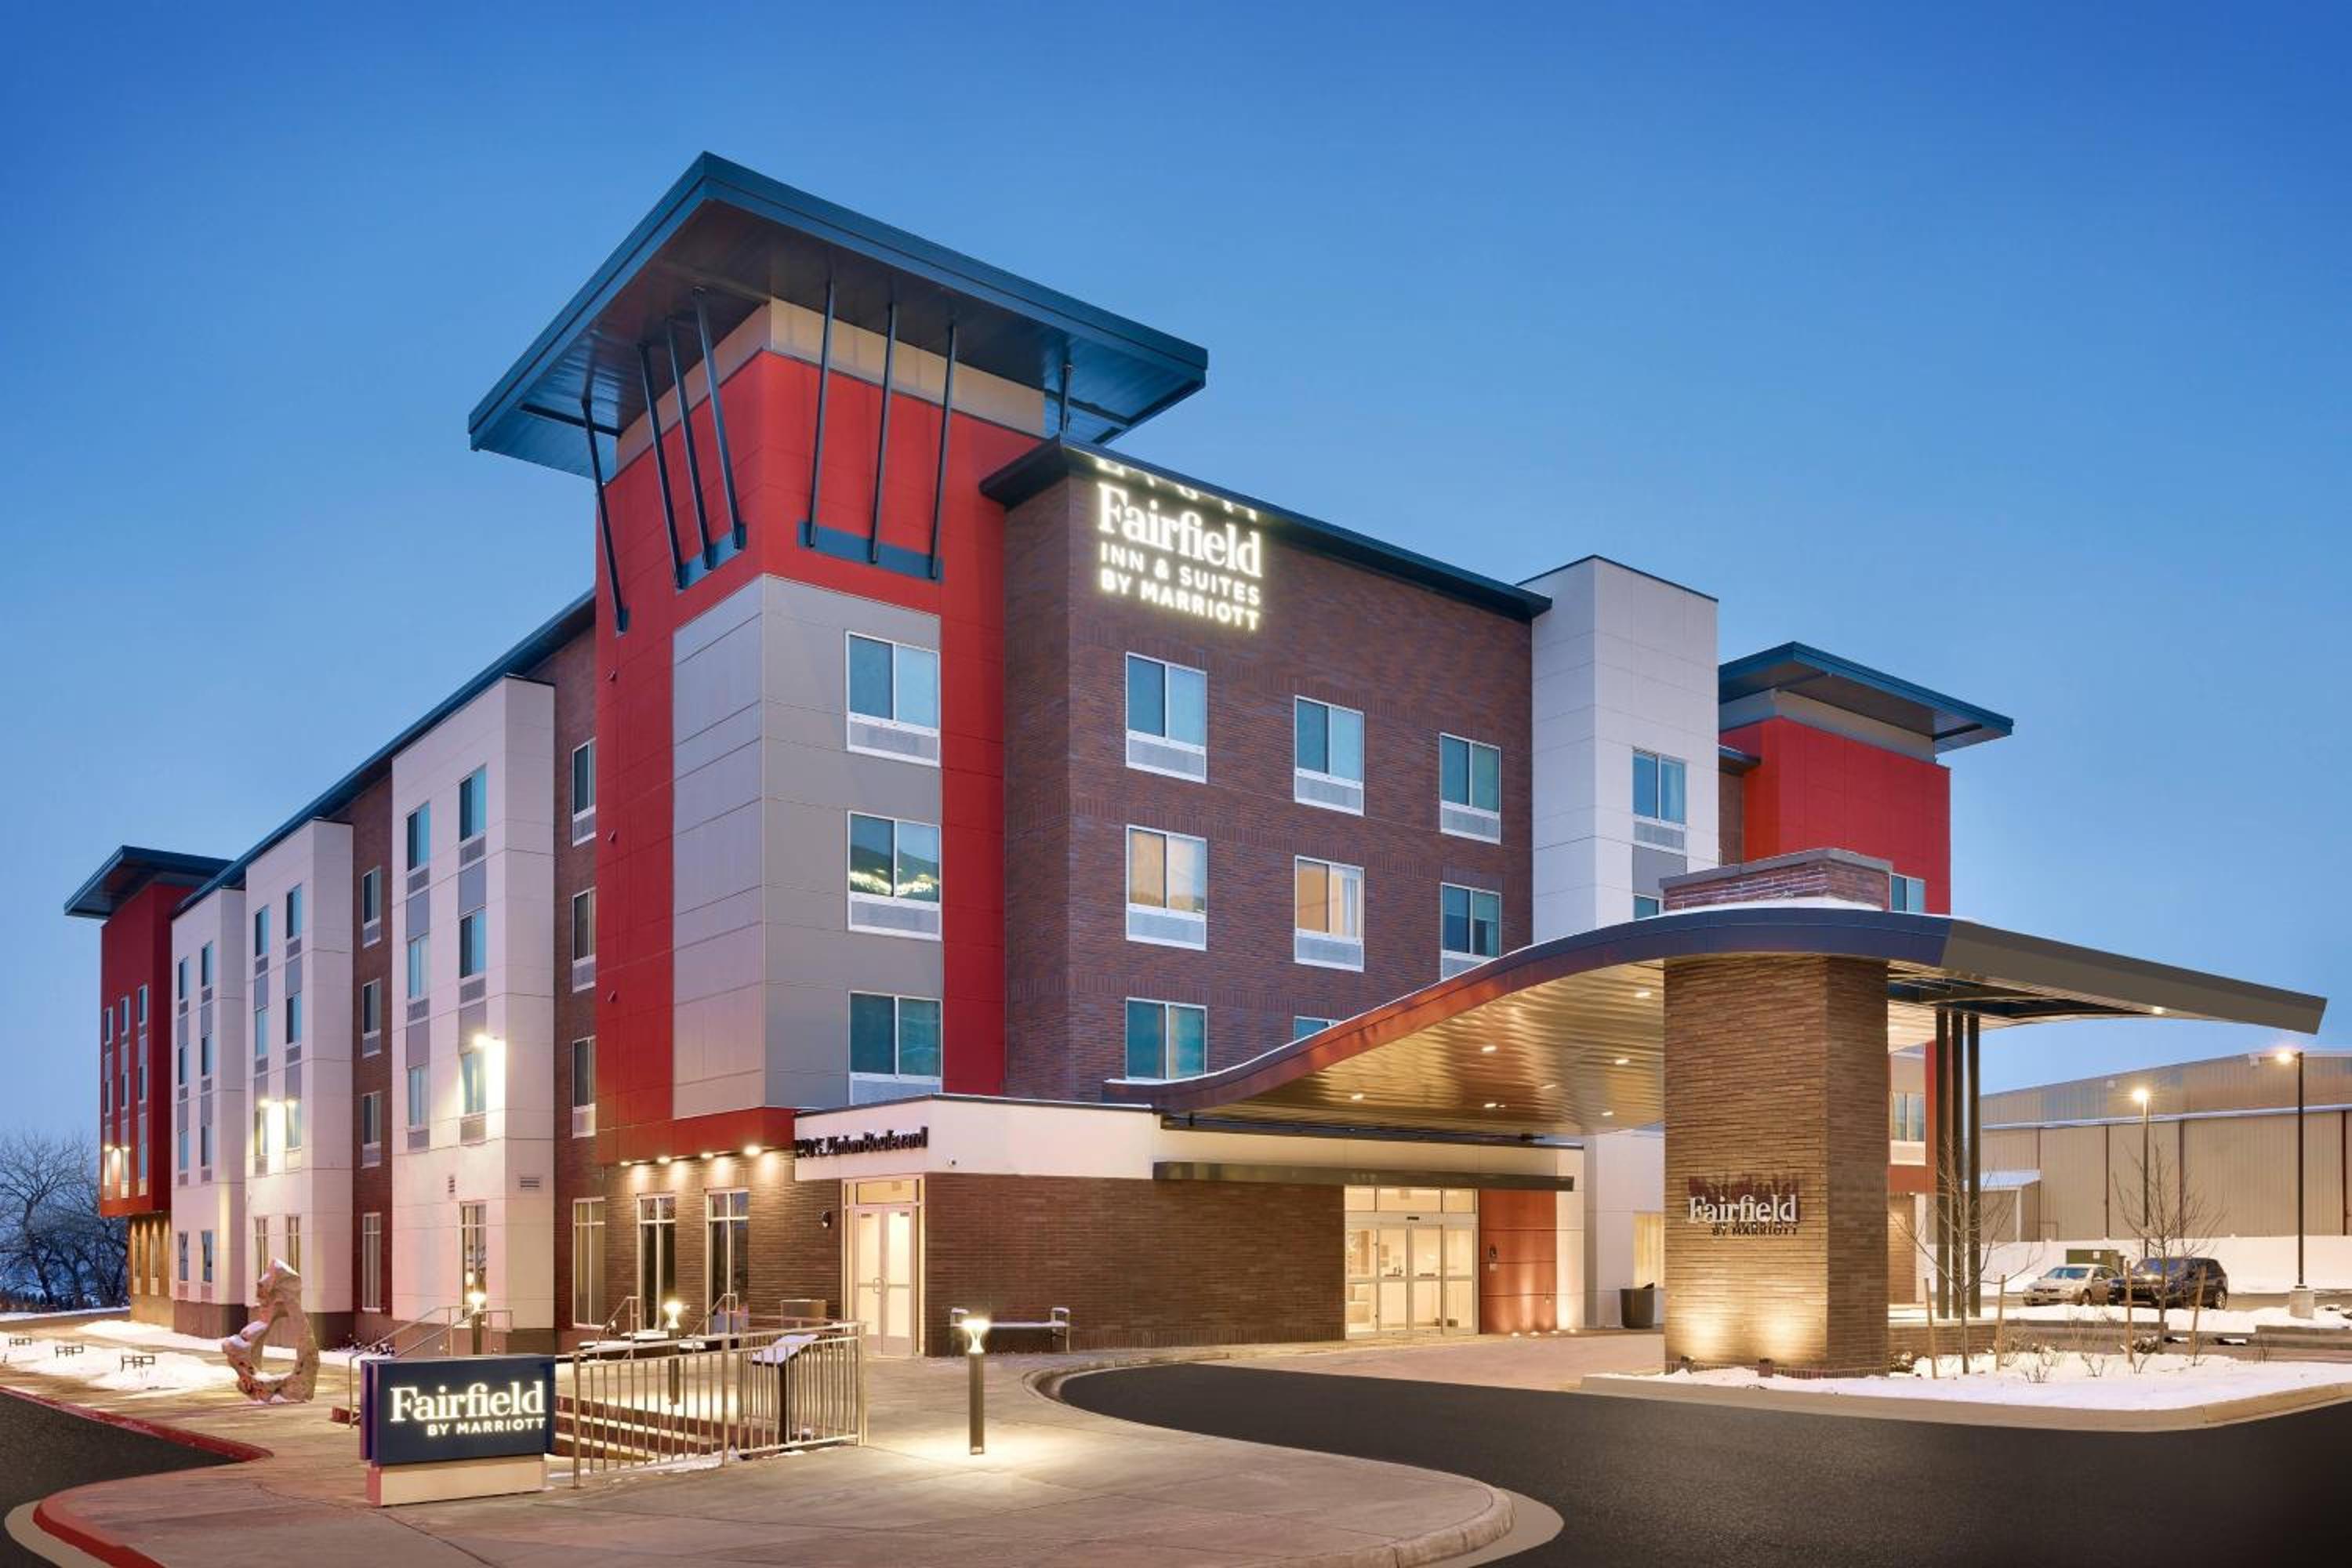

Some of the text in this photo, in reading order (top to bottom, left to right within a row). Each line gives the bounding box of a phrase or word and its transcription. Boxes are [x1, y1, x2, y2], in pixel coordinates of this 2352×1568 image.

[1098, 481, 1262, 578] Fairfield
[1101, 541, 1261, 607] INN & SUITES
[1101, 567, 1260, 631] BY MARRIOTT
[1688, 1194, 1798, 1224] Fairfield
[1732, 1225, 1798, 1236] MARRIOTT
[390, 1381, 546, 1422] Fairfield
[427, 1417, 546, 1436] BY MARRIOTT
